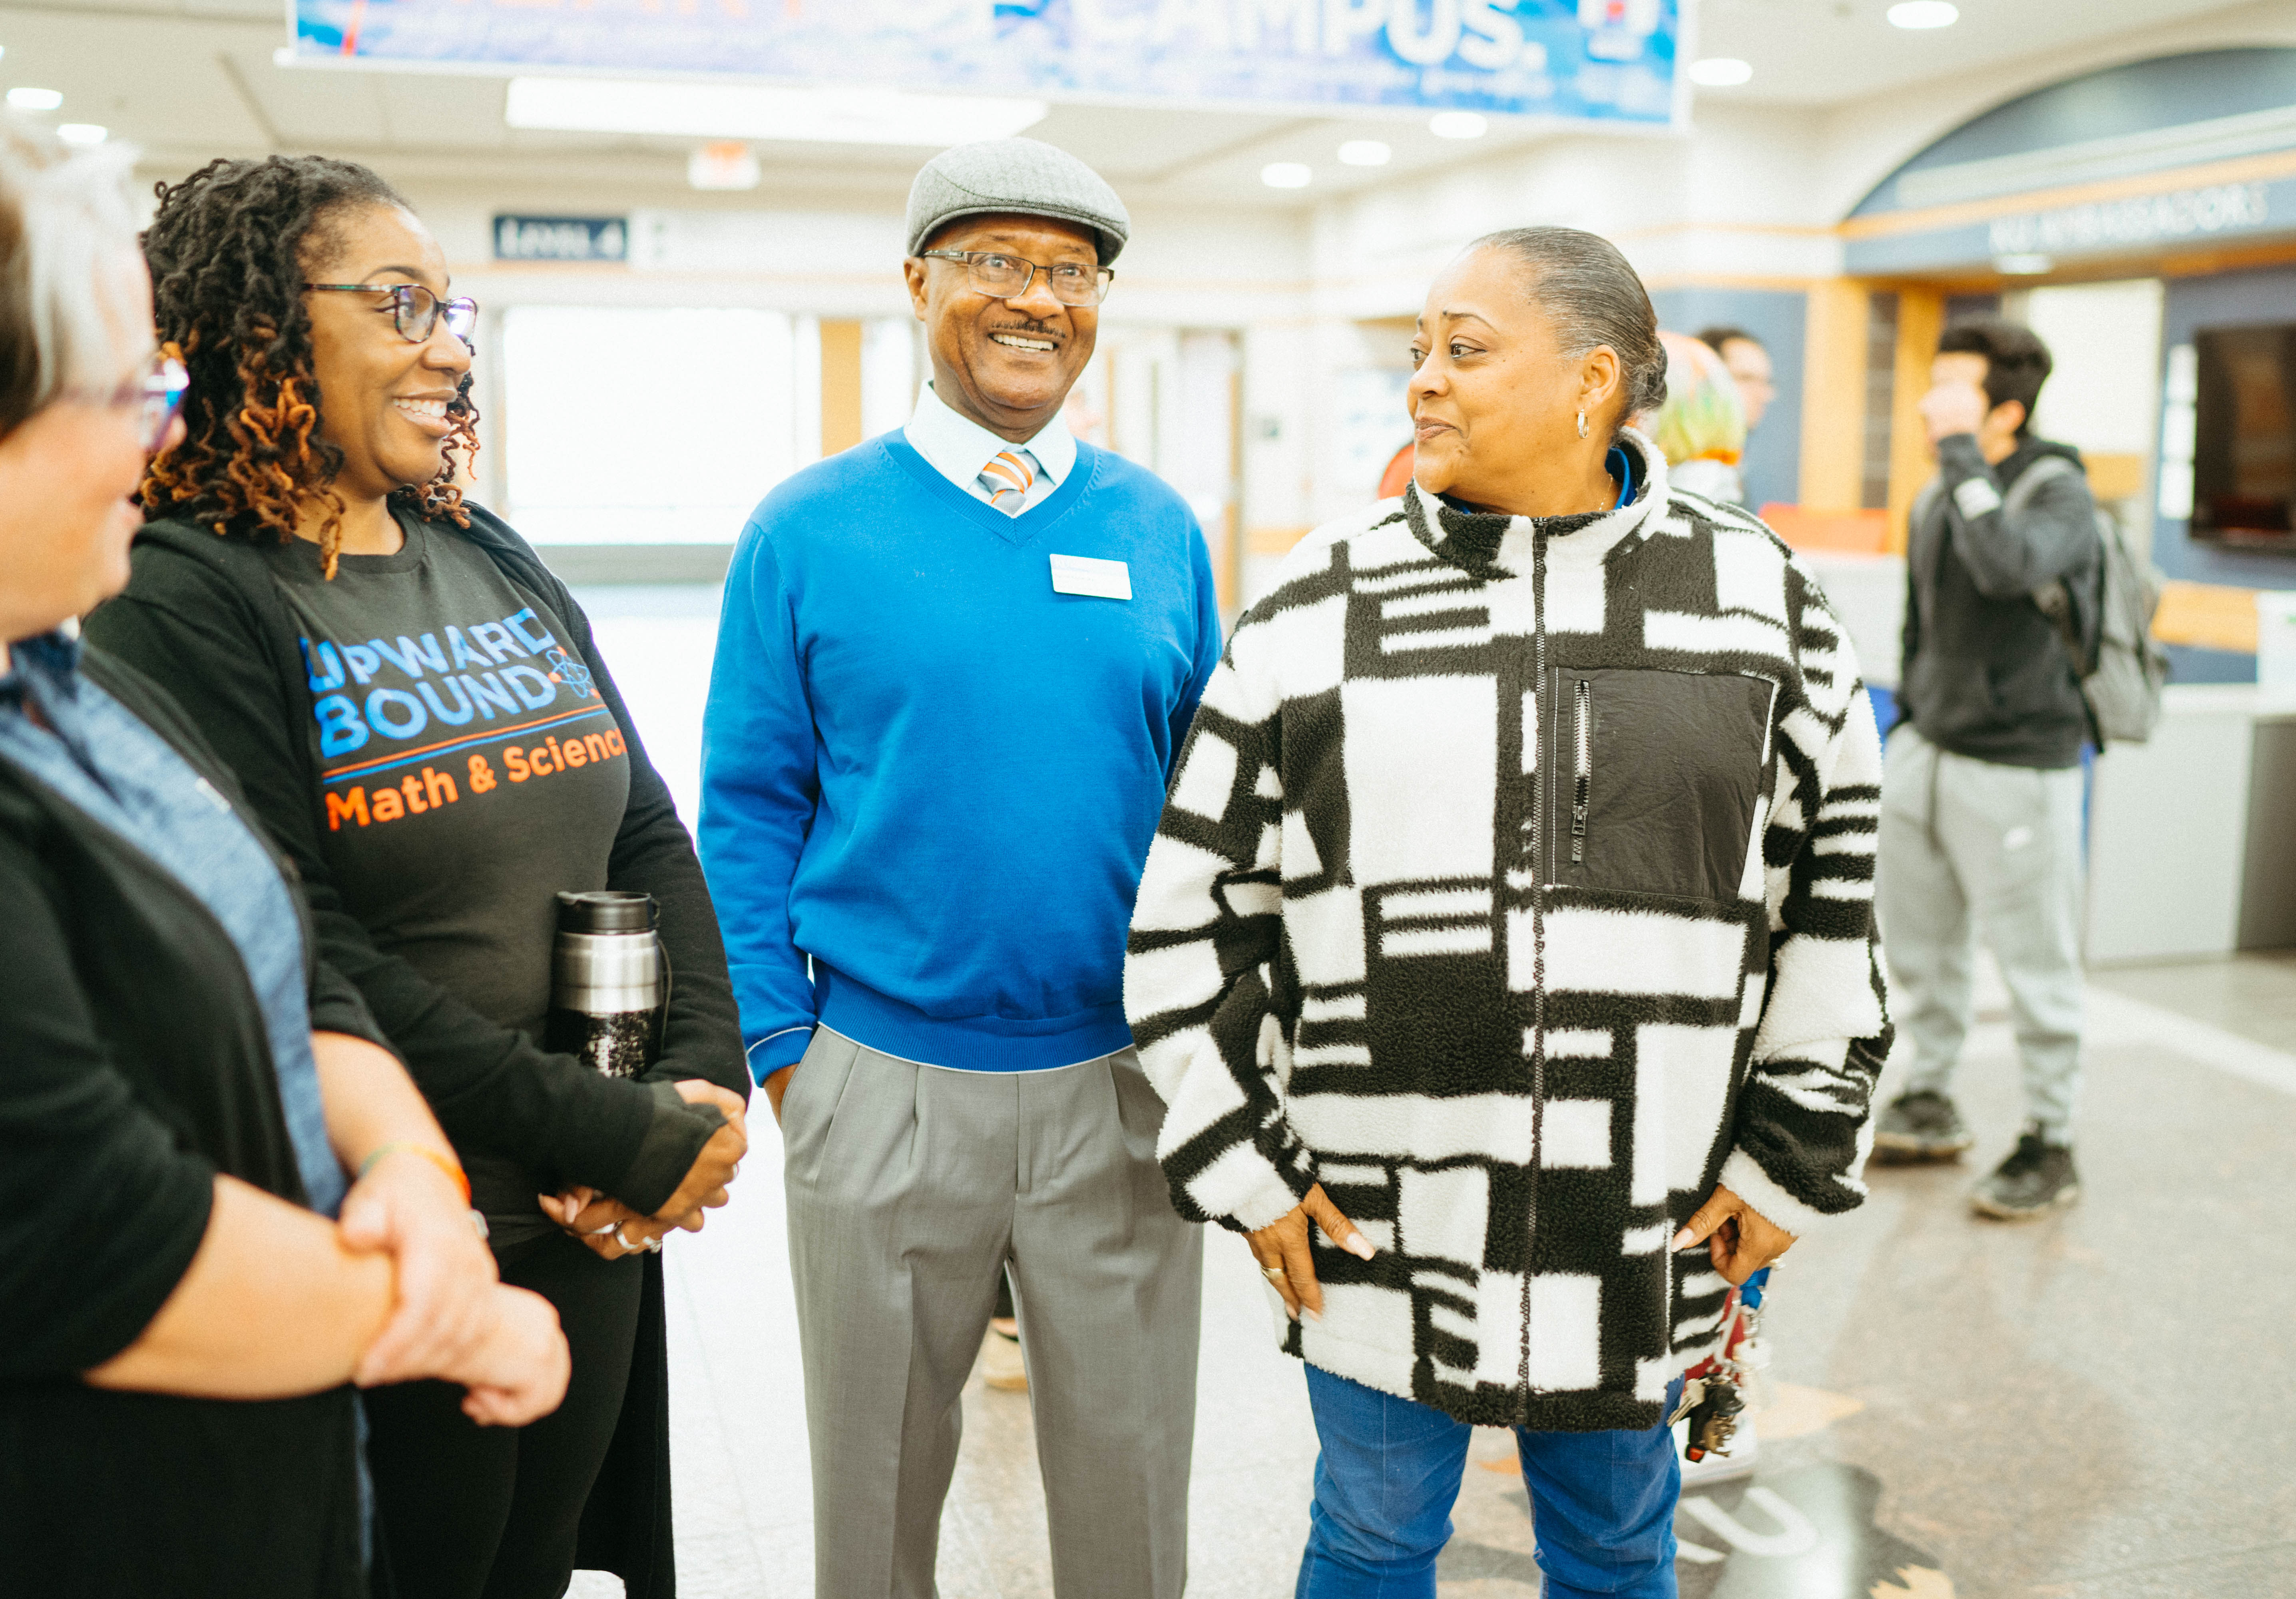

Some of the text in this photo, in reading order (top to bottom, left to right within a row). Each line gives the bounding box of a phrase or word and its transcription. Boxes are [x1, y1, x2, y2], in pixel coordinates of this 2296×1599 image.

[299, 608, 556, 693] UPWARD
[315, 665, 556, 758] BOUND
[325, 766, 459, 831] Math
[467, 754, 497, 794] &
